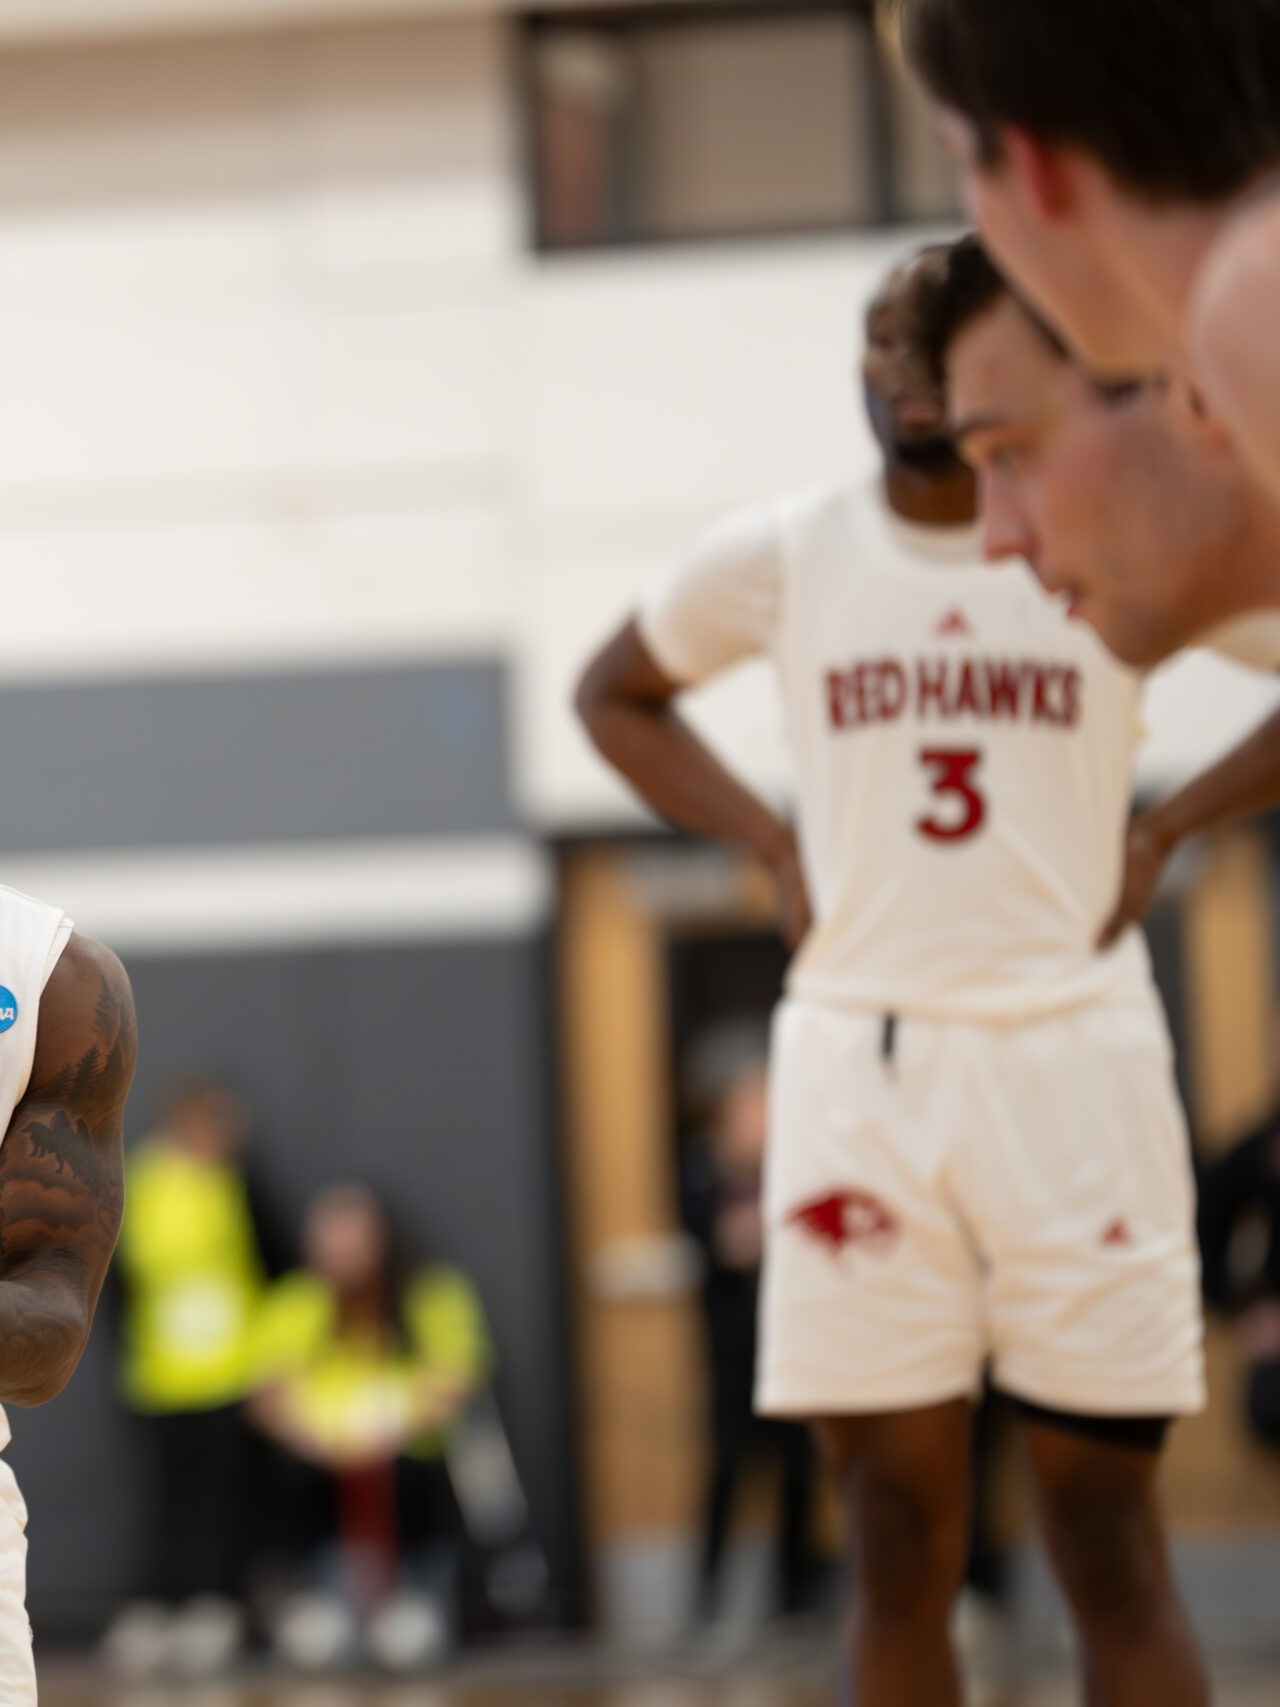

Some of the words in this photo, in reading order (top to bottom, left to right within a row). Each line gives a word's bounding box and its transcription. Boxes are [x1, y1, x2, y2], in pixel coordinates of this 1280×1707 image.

[825, 656, 907, 729] RED
[918, 654, 1083, 730] HAWKS
[916, 745, 988, 846] 3
